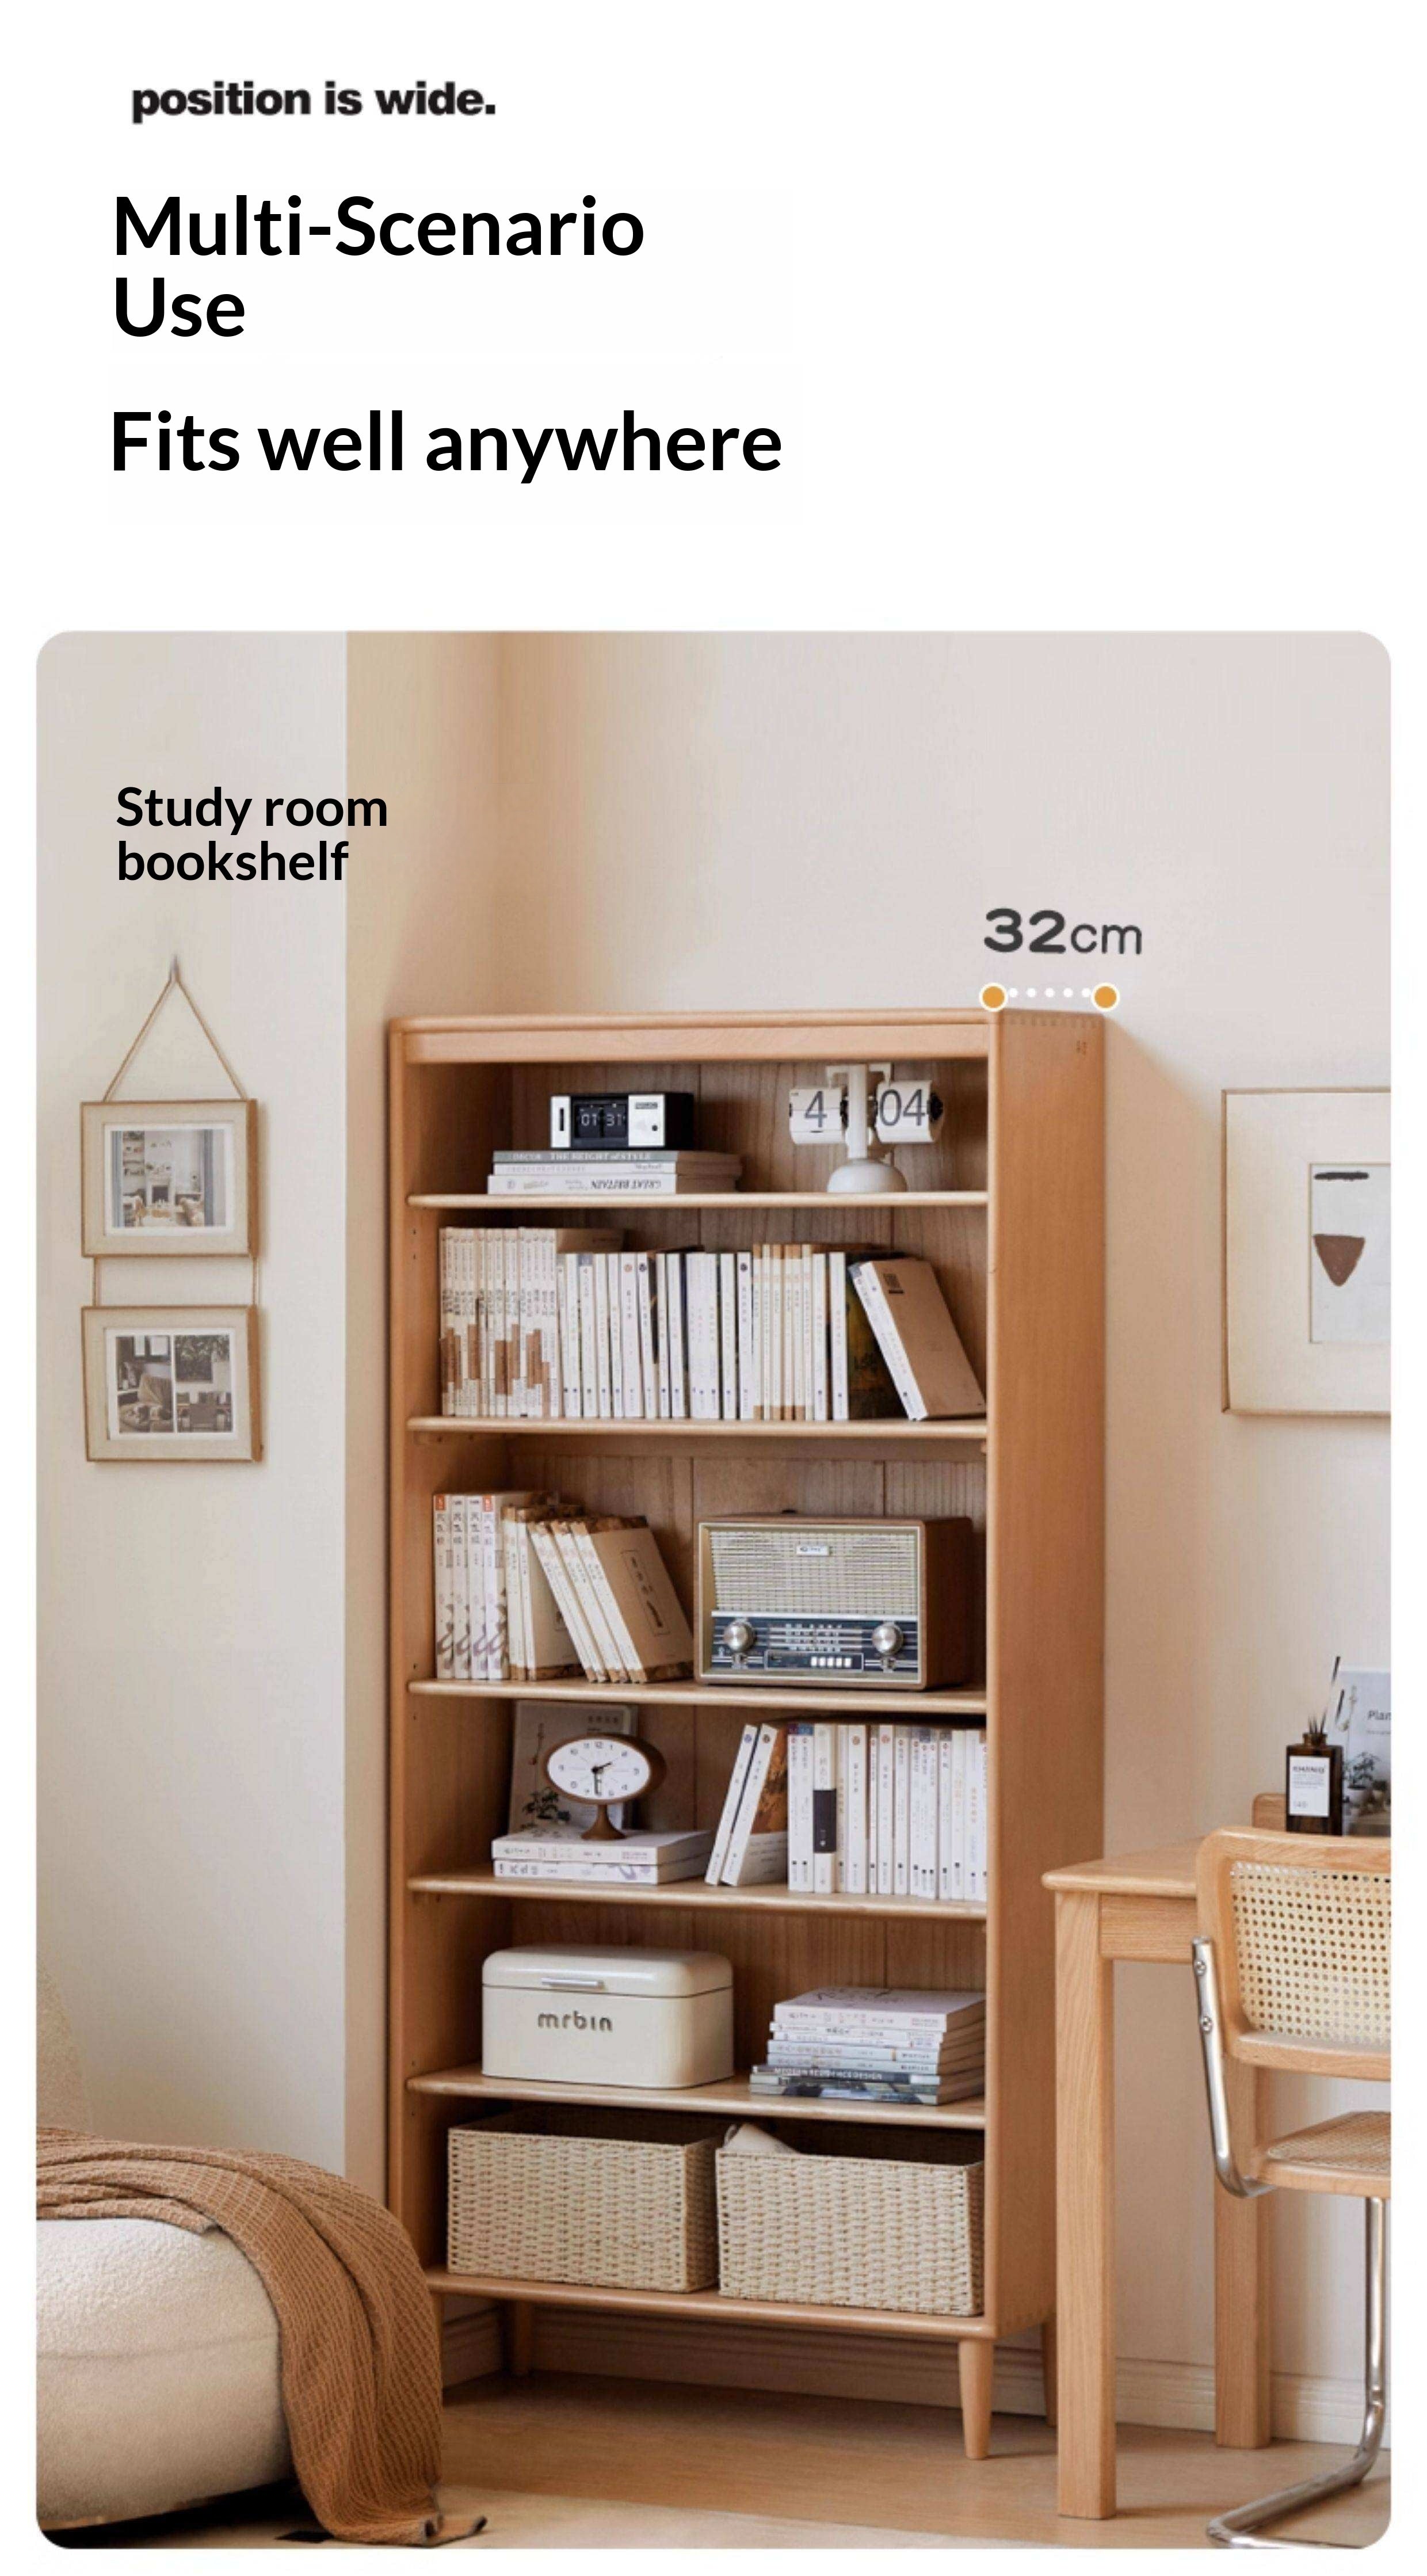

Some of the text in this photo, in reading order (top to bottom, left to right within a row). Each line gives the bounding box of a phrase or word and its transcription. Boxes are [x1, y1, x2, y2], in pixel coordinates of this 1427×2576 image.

[804, 1091, 827, 1127] 4
[880, 1089, 925, 1126] 04
[591, 1179, 629, 1190] BRITAIN
[631, 1179, 662, 1190] GREAT
[537, 2011, 613, 2032] mrbin
